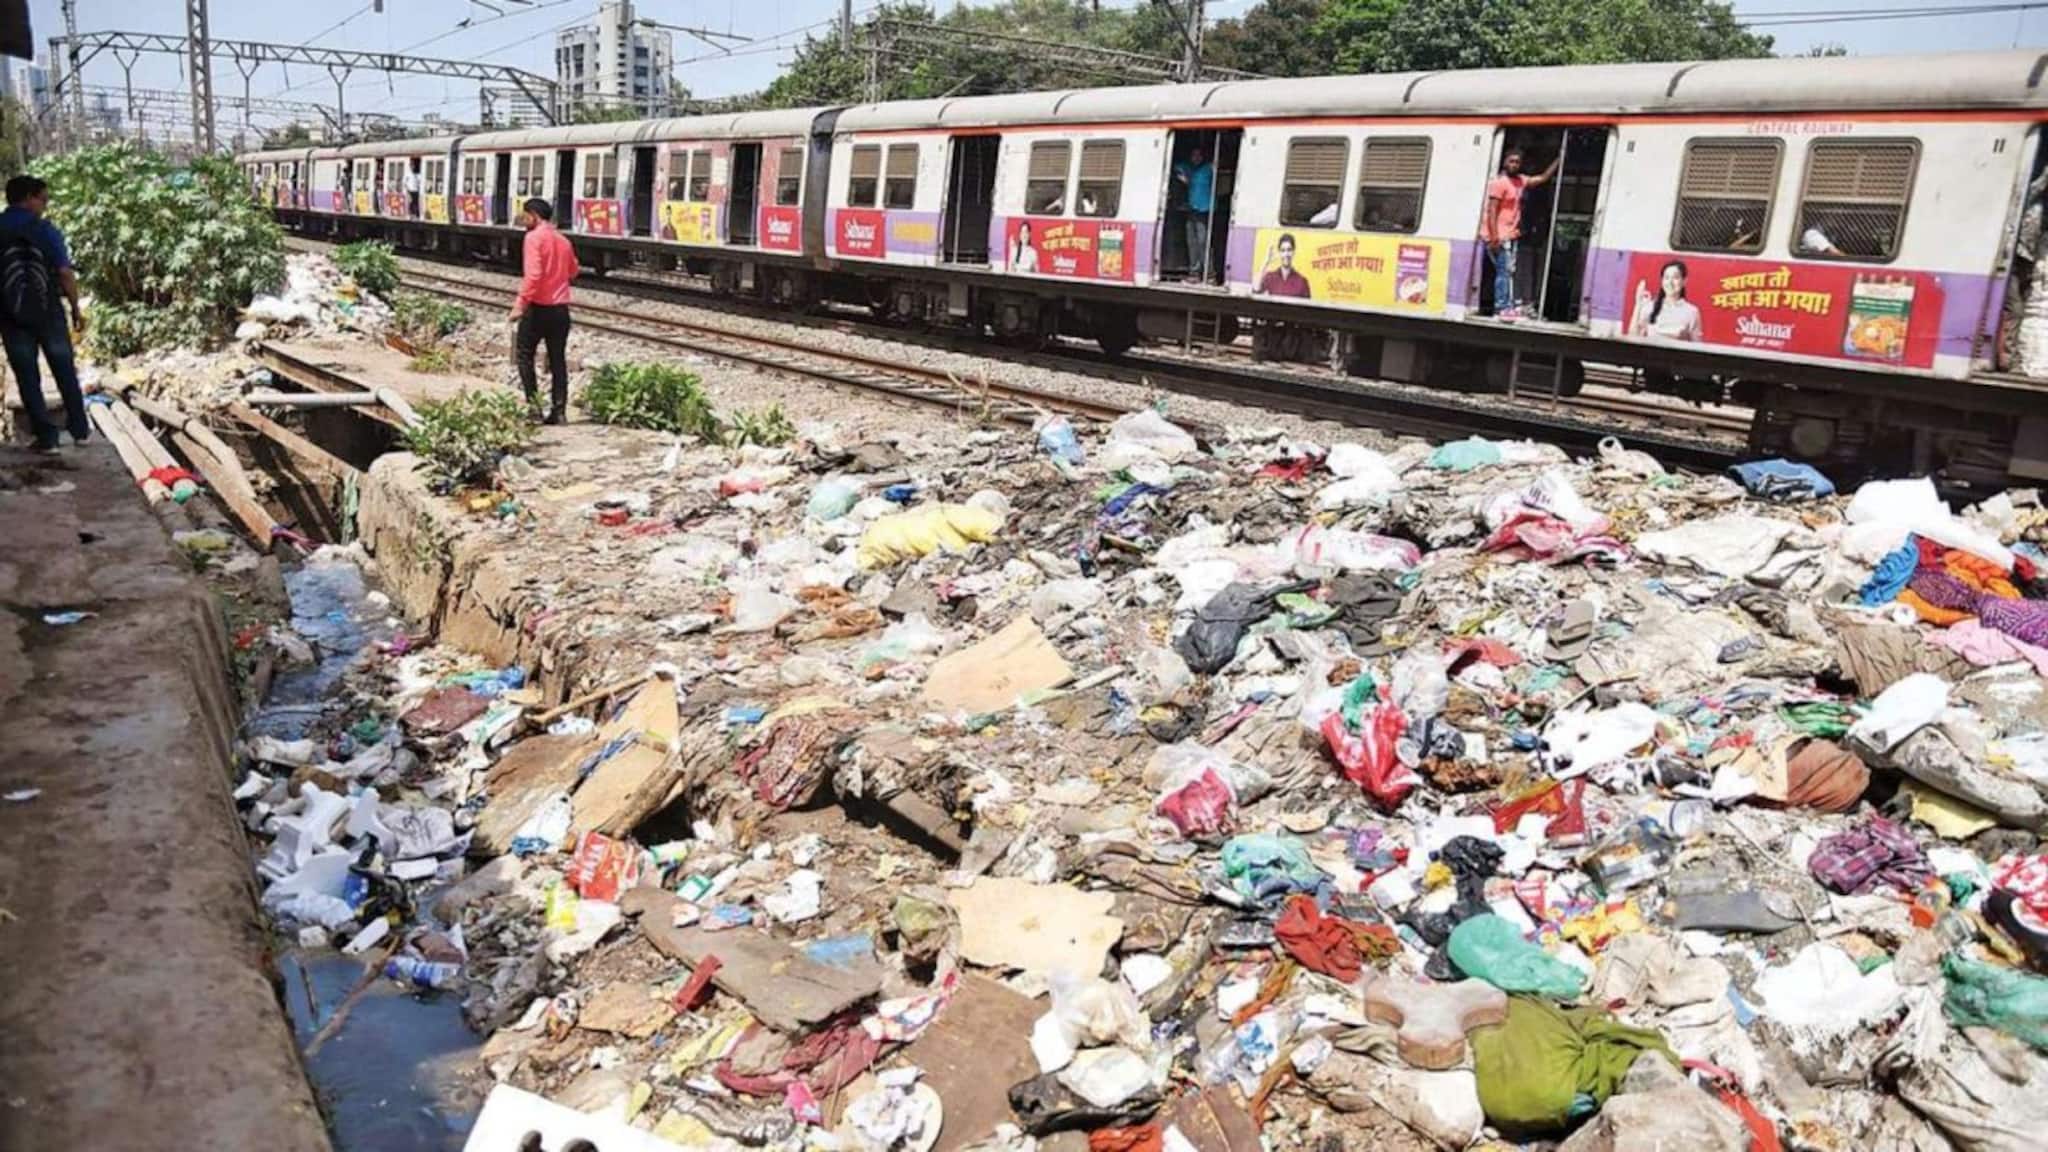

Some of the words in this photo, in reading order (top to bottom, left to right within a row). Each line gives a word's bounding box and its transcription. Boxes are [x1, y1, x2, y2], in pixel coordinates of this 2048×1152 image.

[1746, 121, 1799, 135] CENTRAL
[1802, 120, 1854, 134] RAILWAY
[1768, 265, 1792, 287] तो
[1753, 290, 1781, 308] आ
[1782, 291, 1832, 315] गया!
[1735, 314, 1796, 339] Suhana
